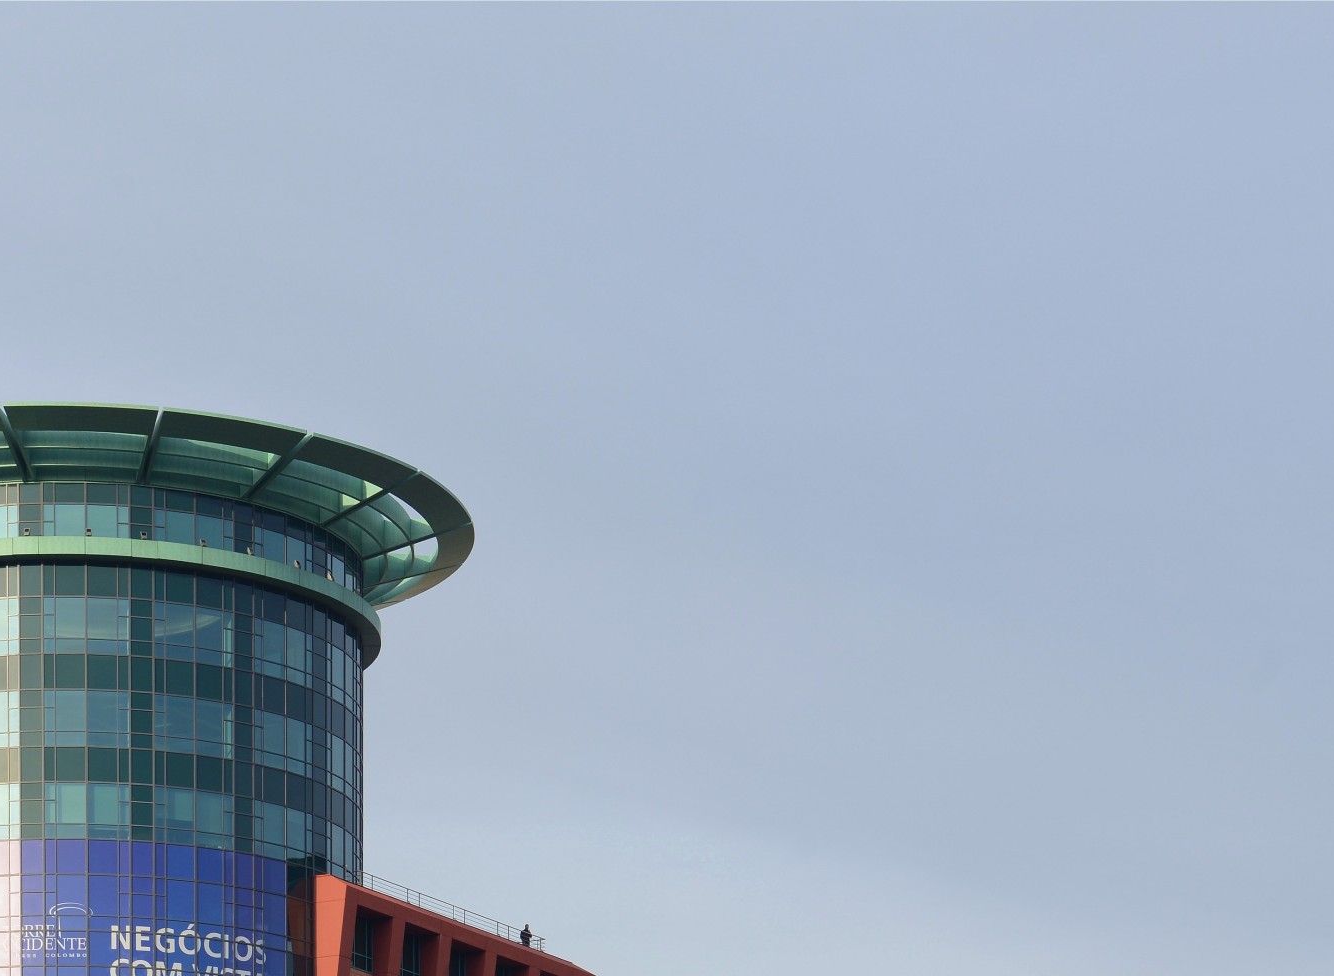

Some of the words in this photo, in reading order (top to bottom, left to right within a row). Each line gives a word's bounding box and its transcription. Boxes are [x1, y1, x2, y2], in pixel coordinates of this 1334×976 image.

[4, 924, 56, 938] RRE
[4, 937, 87, 951] IDENTE
[110, 923, 267, 965] NEGÓCIOS
